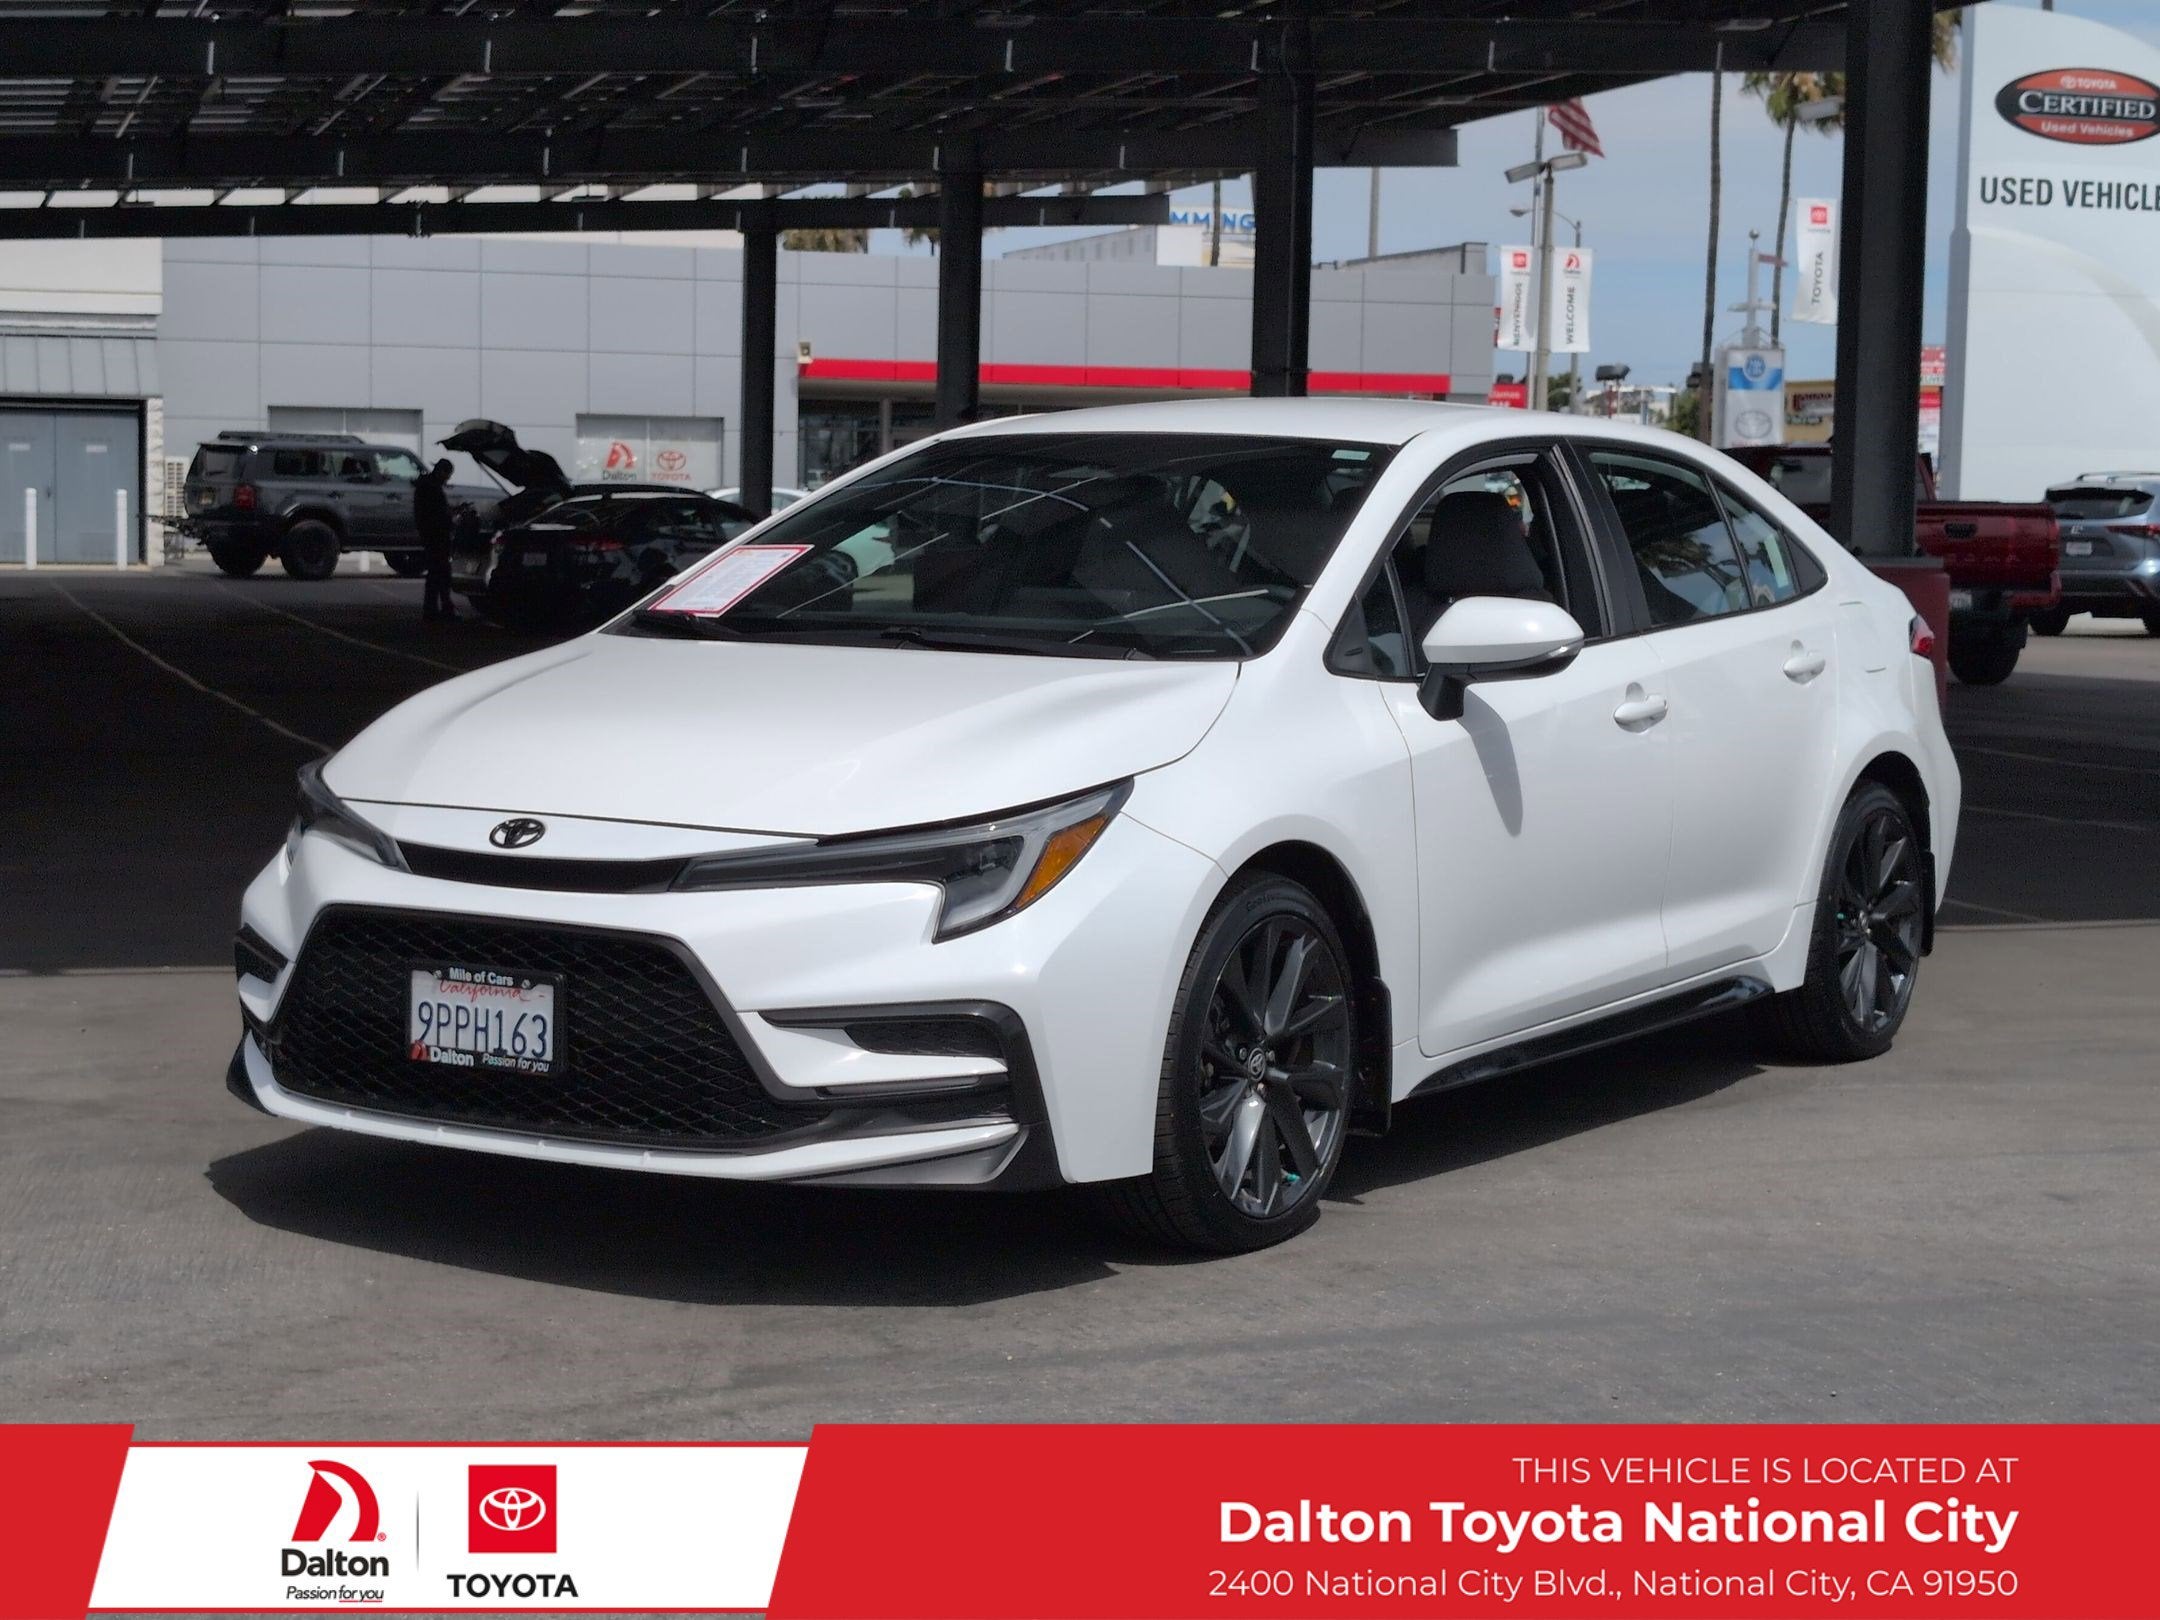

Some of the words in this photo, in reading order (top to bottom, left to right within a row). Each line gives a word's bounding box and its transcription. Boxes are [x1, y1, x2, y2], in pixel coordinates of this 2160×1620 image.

[2077, 78, 2117, 90] TOYOTA
[2018, 90, 2157, 120] CERTIFIED
[2040, 121, 2076, 134] Used
[2080, 123, 2135, 138] Vehicles
[1979, 176, 2053, 207] USED
[1811, 250, 1824, 305] TOYOTA
[1566, 286, 1576, 345] WELCOME
[449, 967, 472, 979] Mile
[473, 971, 486, 981] of
[487, 972, 514, 986] Cars
[418, 1001, 548, 1058] 9PPH163
[430, 1047, 475, 1067] Dalton
[482, 1053, 516, 1068] Passion
[517, 1057, 533, 1069] for
[532, 1061, 550, 1072] you
